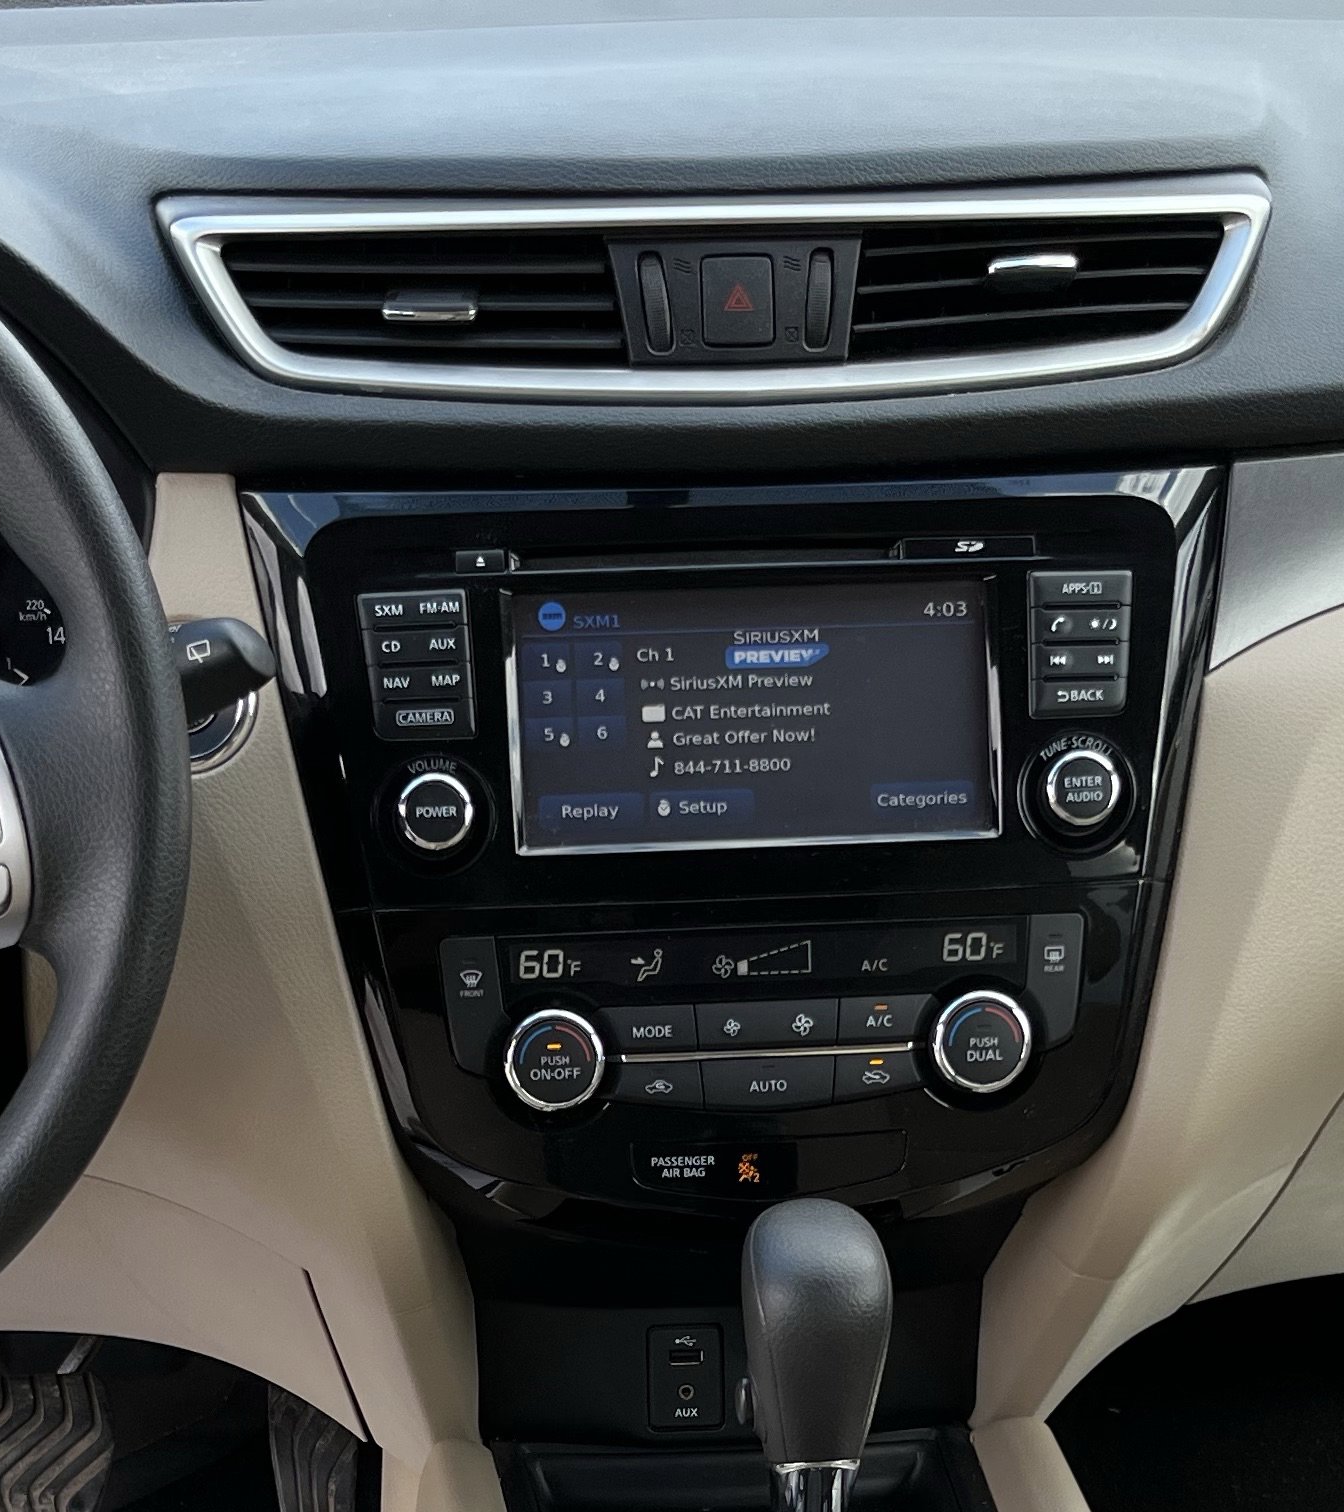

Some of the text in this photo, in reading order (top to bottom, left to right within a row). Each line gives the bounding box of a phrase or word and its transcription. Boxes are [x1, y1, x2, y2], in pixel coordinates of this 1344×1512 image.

[26, 600, 45, 611] 220
[374, 604, 404, 617] SXM
[923, 601, 967, 618] 4:03
[573, 614, 621, 629] SXM1
[46, 626, 66, 645] 14
[381, 640, 401, 653] CD
[429, 638, 456, 650] AUX
[541, 654, 550, 667] 1
[594, 652, 604, 666] 2
[636, 647, 675, 662] Ch 1
[383, 677, 410, 689] NAV
[431, 674, 460, 687] MAP
[670, 672, 814, 691] SiriusXM Preview
[542, 691, 553, 704] 3
[595, 689, 605, 702] 4
[1070, 689, 1104, 701] BACK
[399, 711, 452, 724] CAMERA
[671, 701, 831, 721] CAT Entertainment
[544, 728, 554, 741] 5
[597, 727, 607, 740] 6
[672, 728, 816, 746] Great Offer Now!
[407, 758, 457, 774] VOLUME
[674, 757, 792, 775] 844-711-8800
[1064, 776, 1102, 788] ENTER
[877, 790, 968, 809] Categories
[1066, 791, 1103, 803] AUDIO
[415, 805, 457, 818] POWER
[561, 803, 619, 821] Replay
[679, 799, 728, 818] Setup
[861, 958, 888, 972] A/C
[866, 1014, 893, 1028] A/C
[632, 1025, 673, 1038] MODE
[970, 1037, 998, 1048] PUSH
[540, 1056, 570, 1067] PUSH
[966, 1049, 1004, 1062] DUAL
[750, 1079, 788, 1093] AUTO
[651, 1156, 715, 1168] PASSENGER
[662, 1167, 706, 1179] AIR BAG
[674, 1408, 698, 1418] AUX
